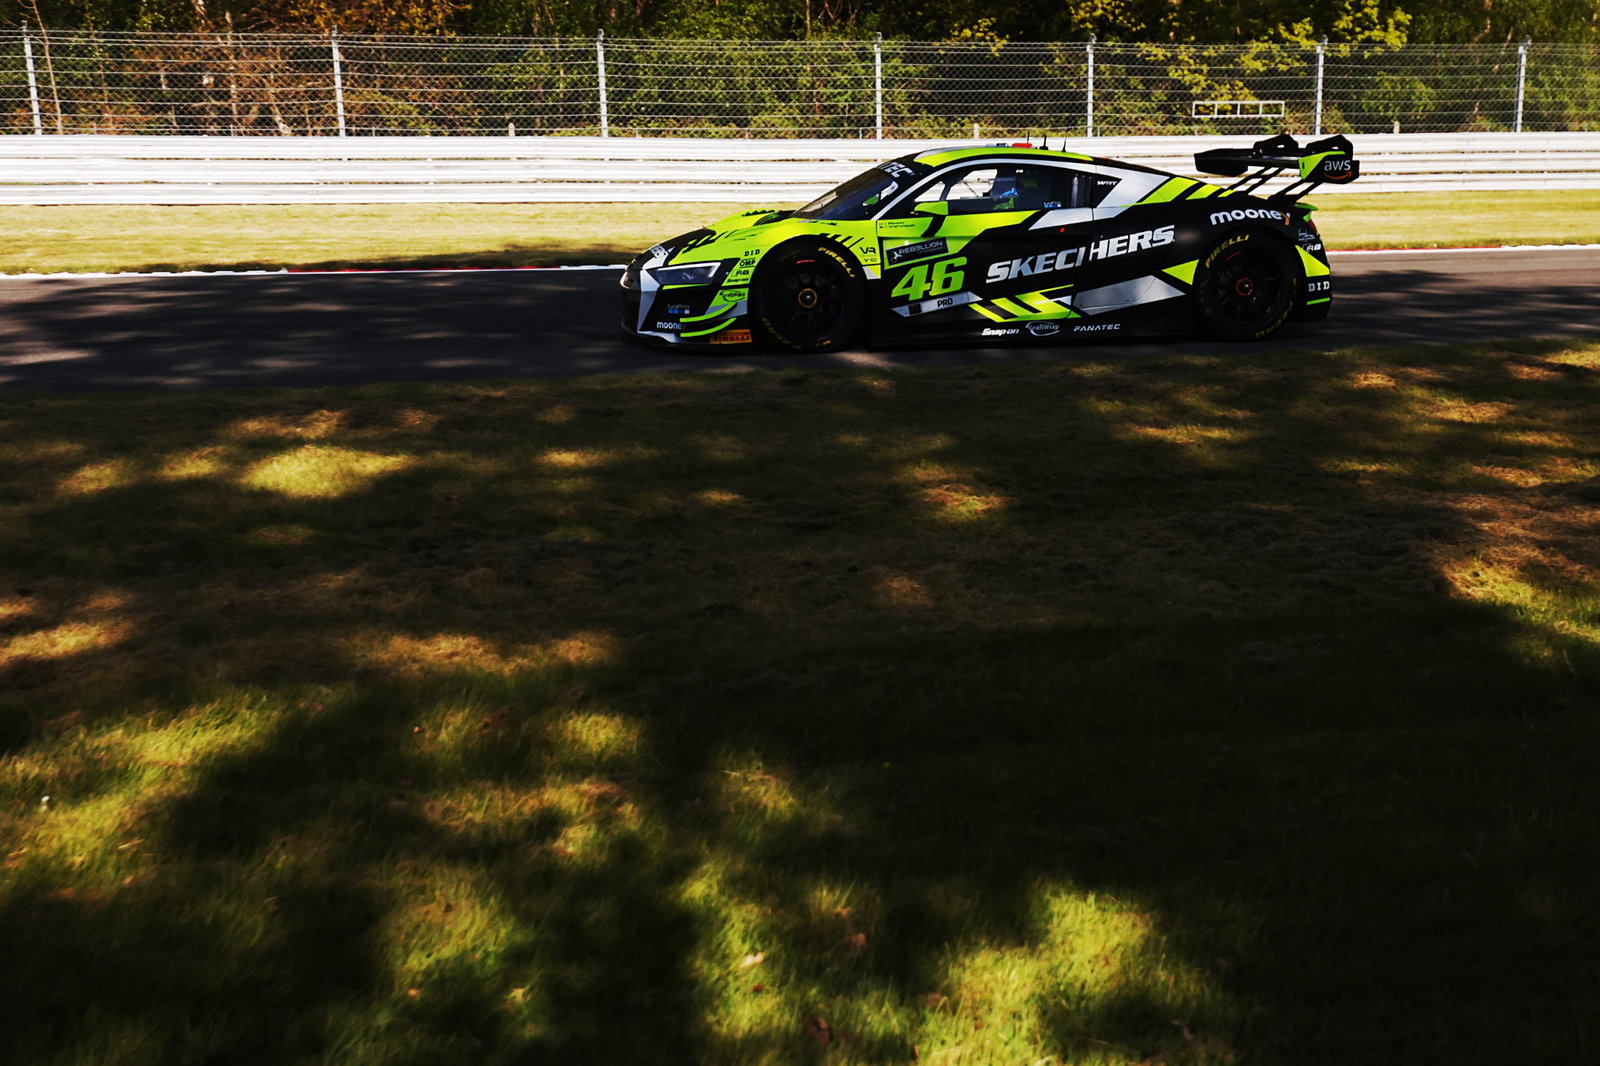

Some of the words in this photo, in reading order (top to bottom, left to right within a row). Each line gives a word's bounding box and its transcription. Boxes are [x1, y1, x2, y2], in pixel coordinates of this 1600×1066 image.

[1324, 160, 1351, 171] aws
[1210, 209, 1291, 226] mooney
[818, 247, 855, 278] PIRELLI
[986, 225, 1176, 283] SKECHERS
[1205, 234, 1250, 268] PIRELLI
[891, 256, 967, 301] 46
[937, 298, 953, 307] PRO
[1073, 323, 1121, 332] FANATEC
